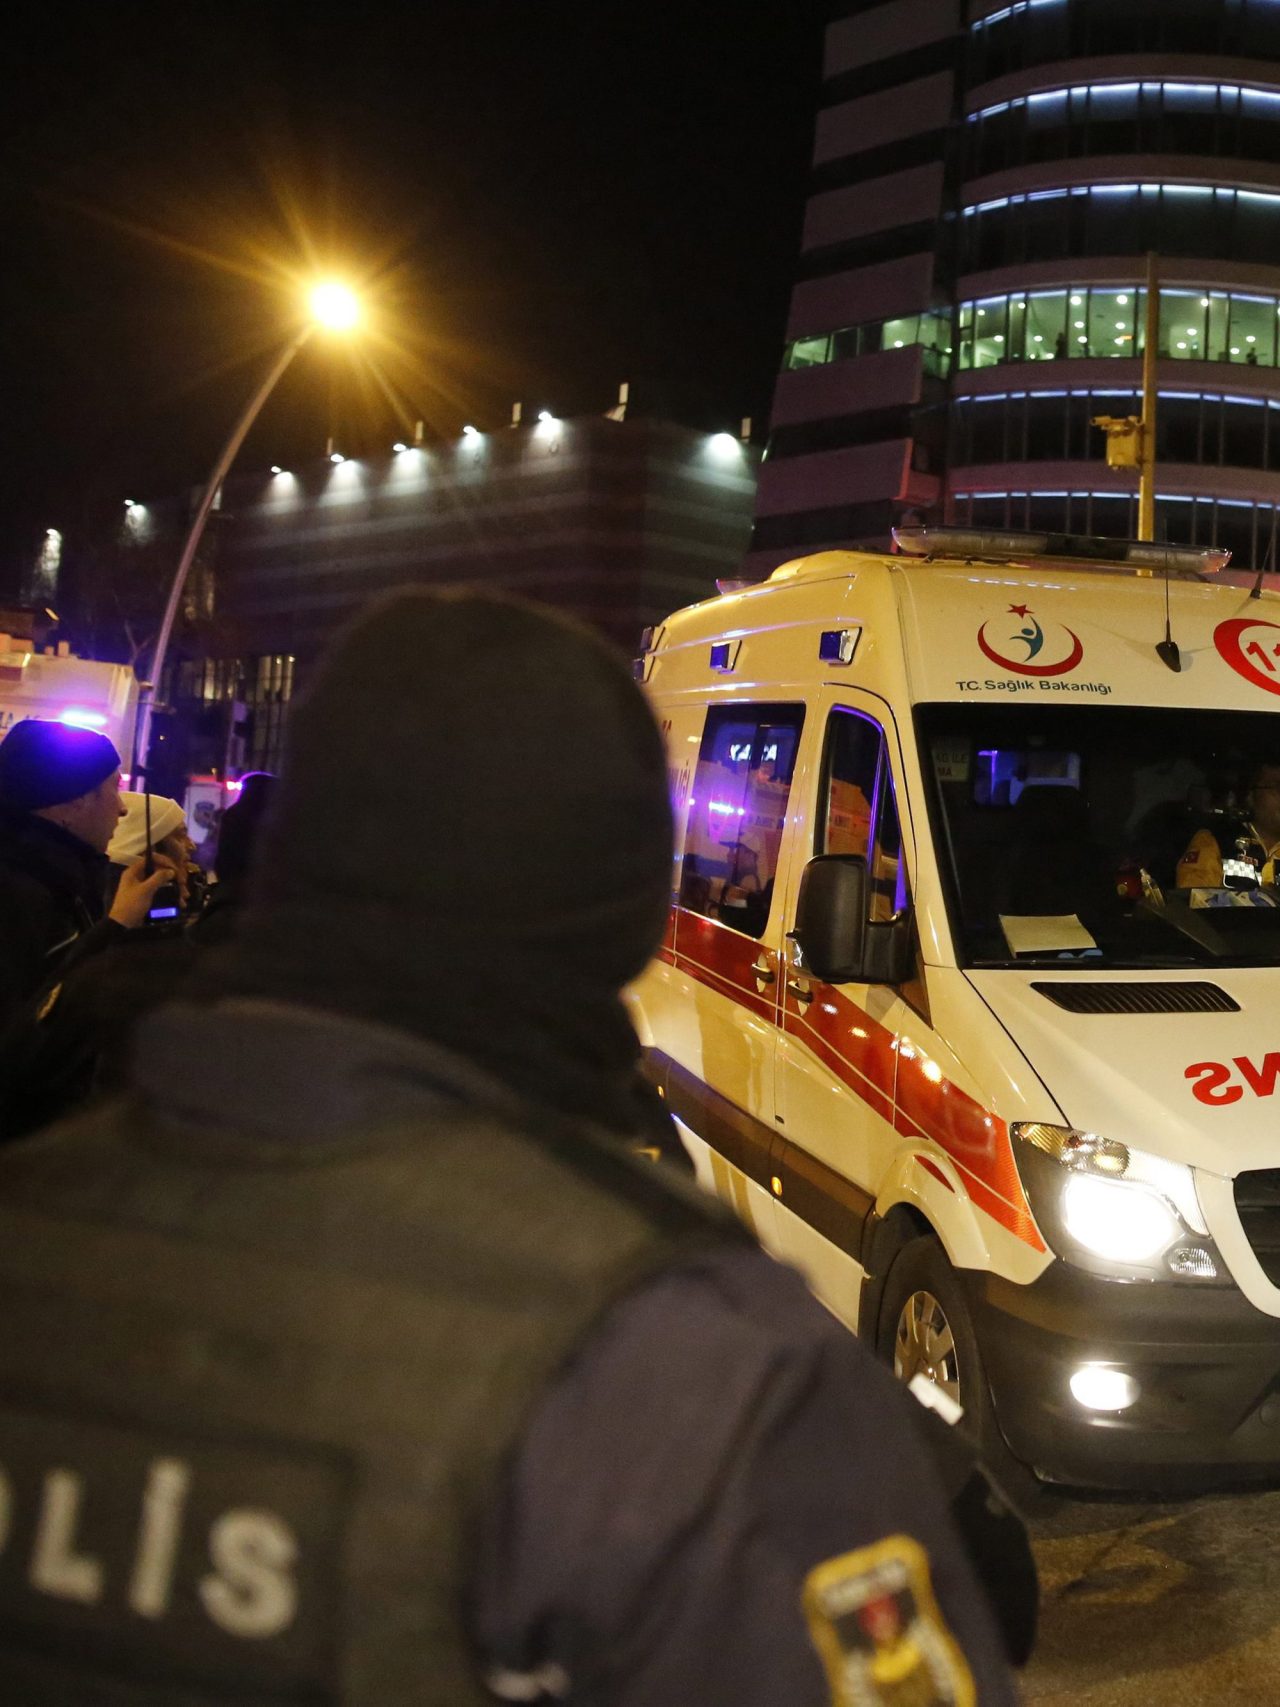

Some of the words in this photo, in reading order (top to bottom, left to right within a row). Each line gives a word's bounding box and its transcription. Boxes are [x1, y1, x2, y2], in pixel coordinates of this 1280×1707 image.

[956, 681, 982, 691] T.C.
[985, 680, 1035, 692] Sağlık
[1039, 680, 1112, 695] Bakanlığı
[0, 1455, 298, 1640] LİS
